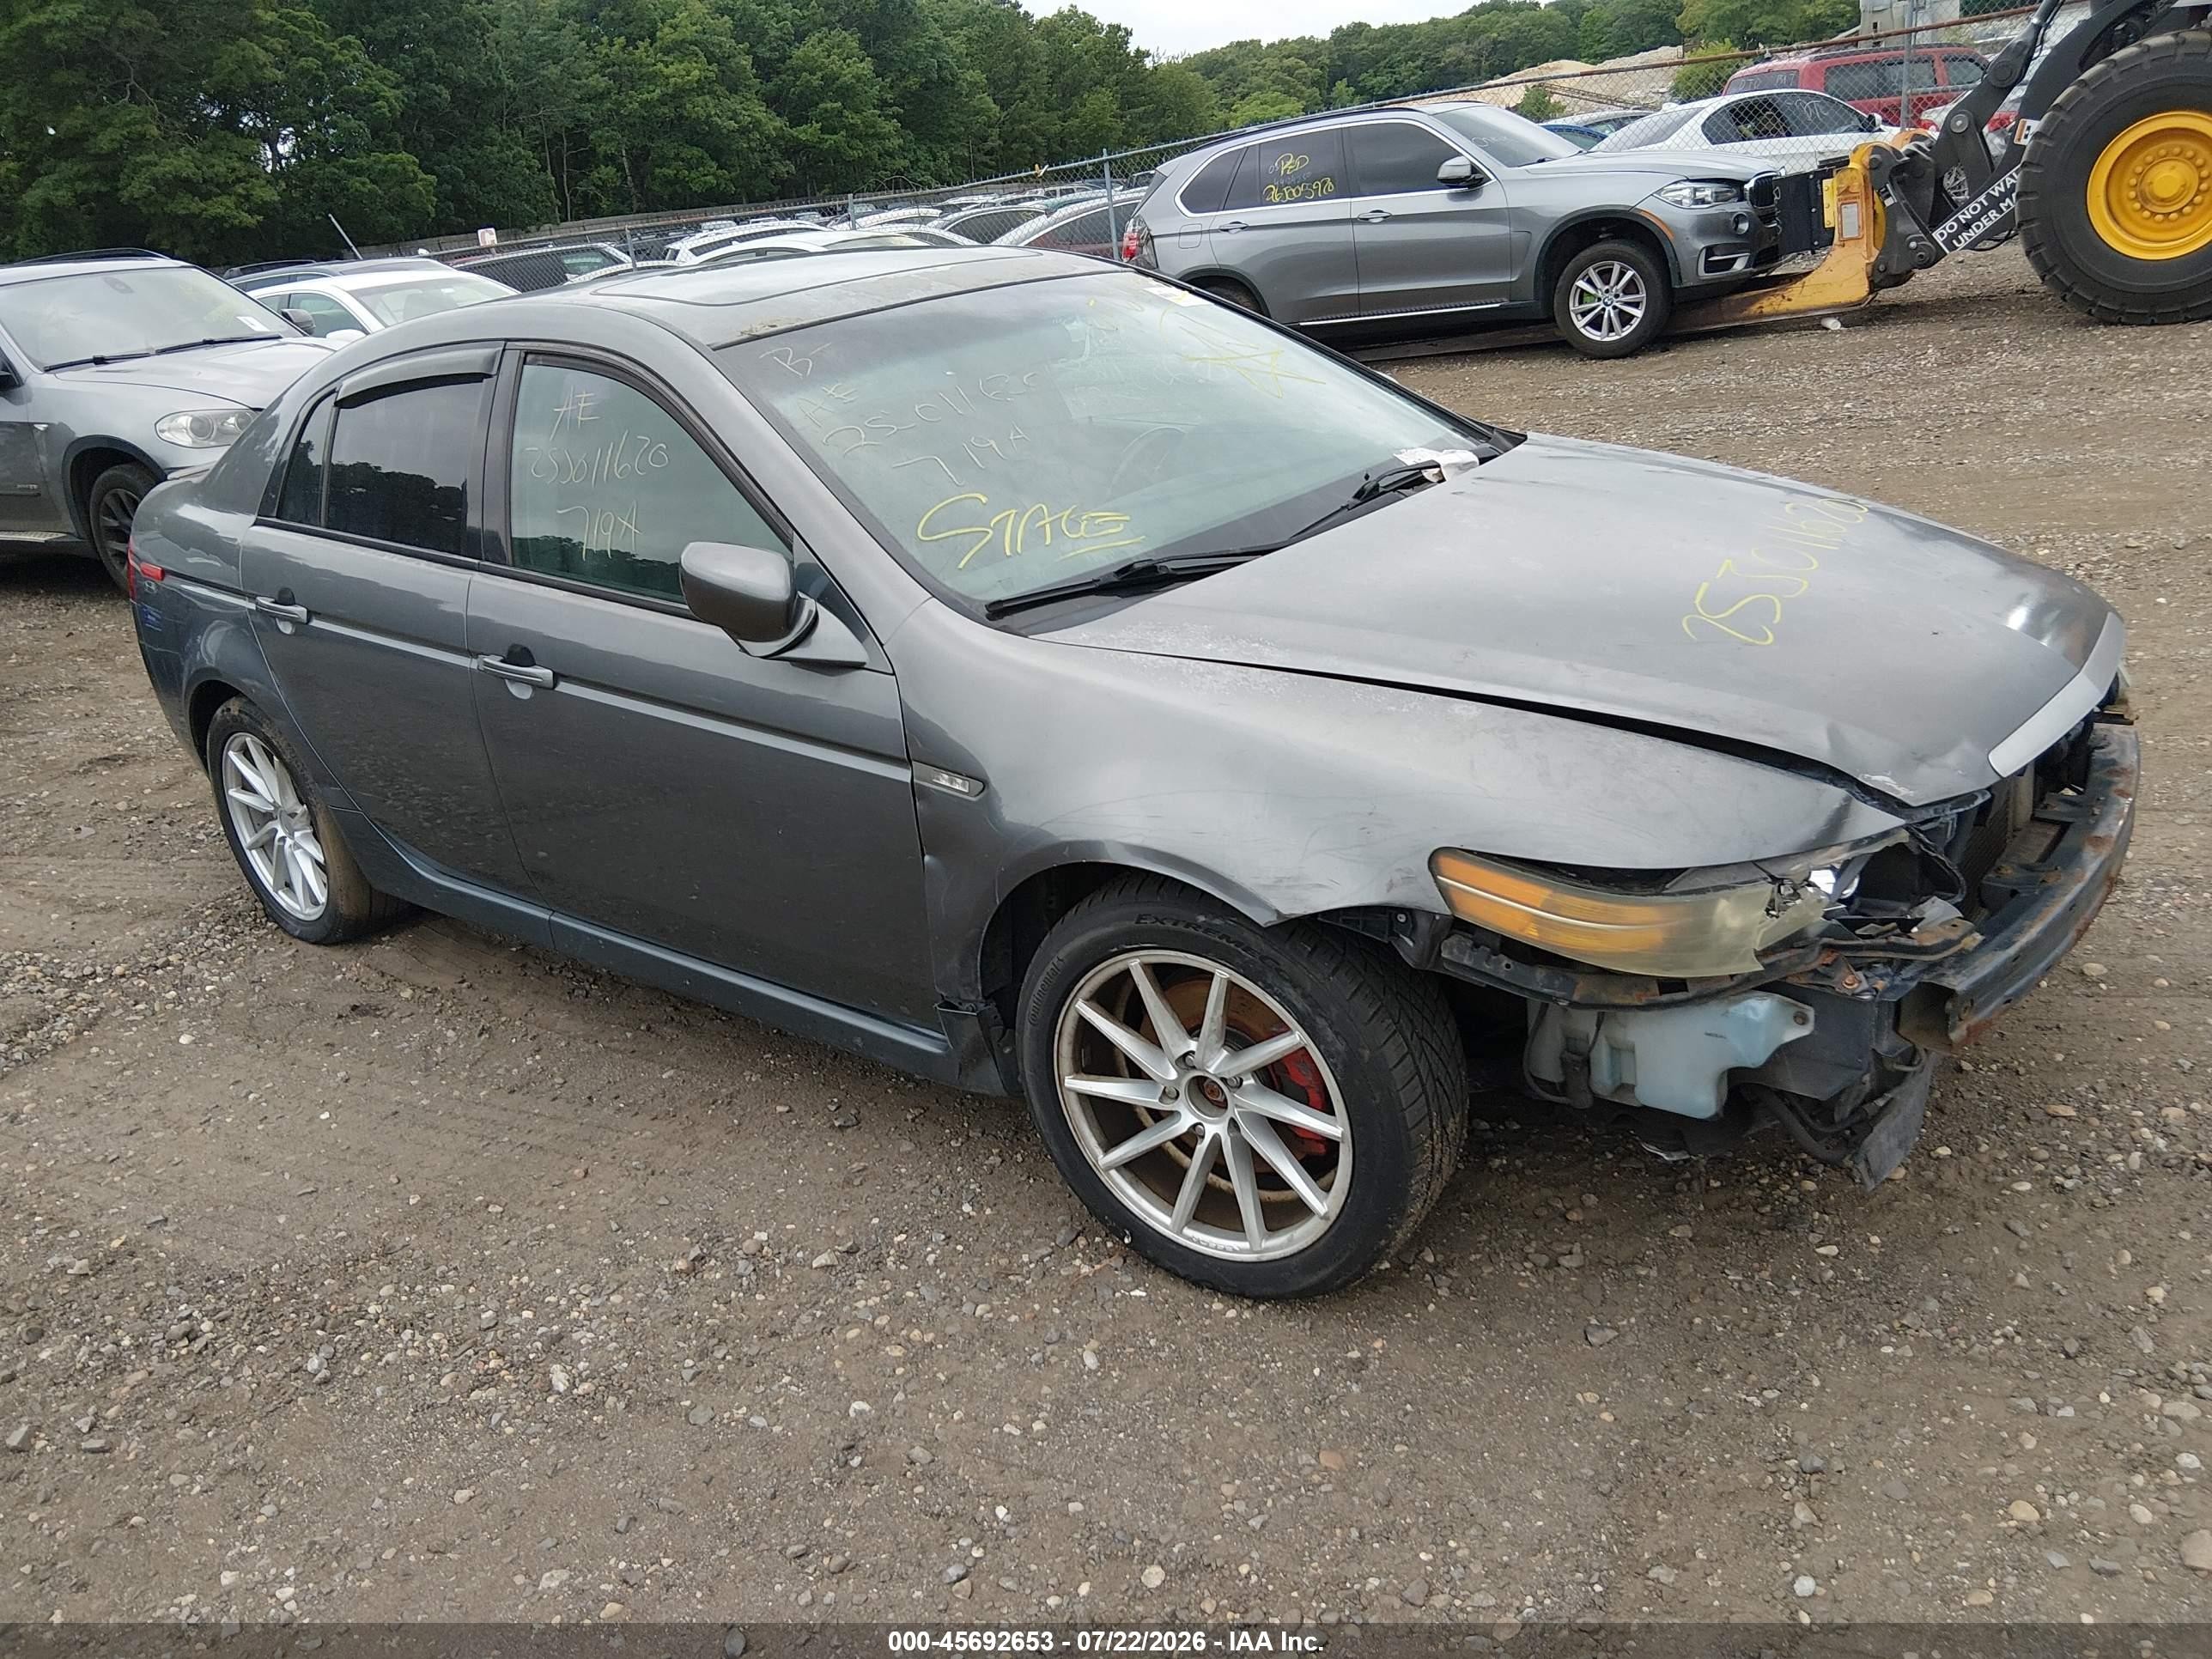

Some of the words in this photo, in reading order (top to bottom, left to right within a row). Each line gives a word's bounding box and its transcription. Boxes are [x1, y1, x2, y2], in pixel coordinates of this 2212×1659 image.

[1936, 221, 1958, 241] DO
[1958, 194, 1989, 224] NOT
[1952, 209, 2001, 247] UNDER
